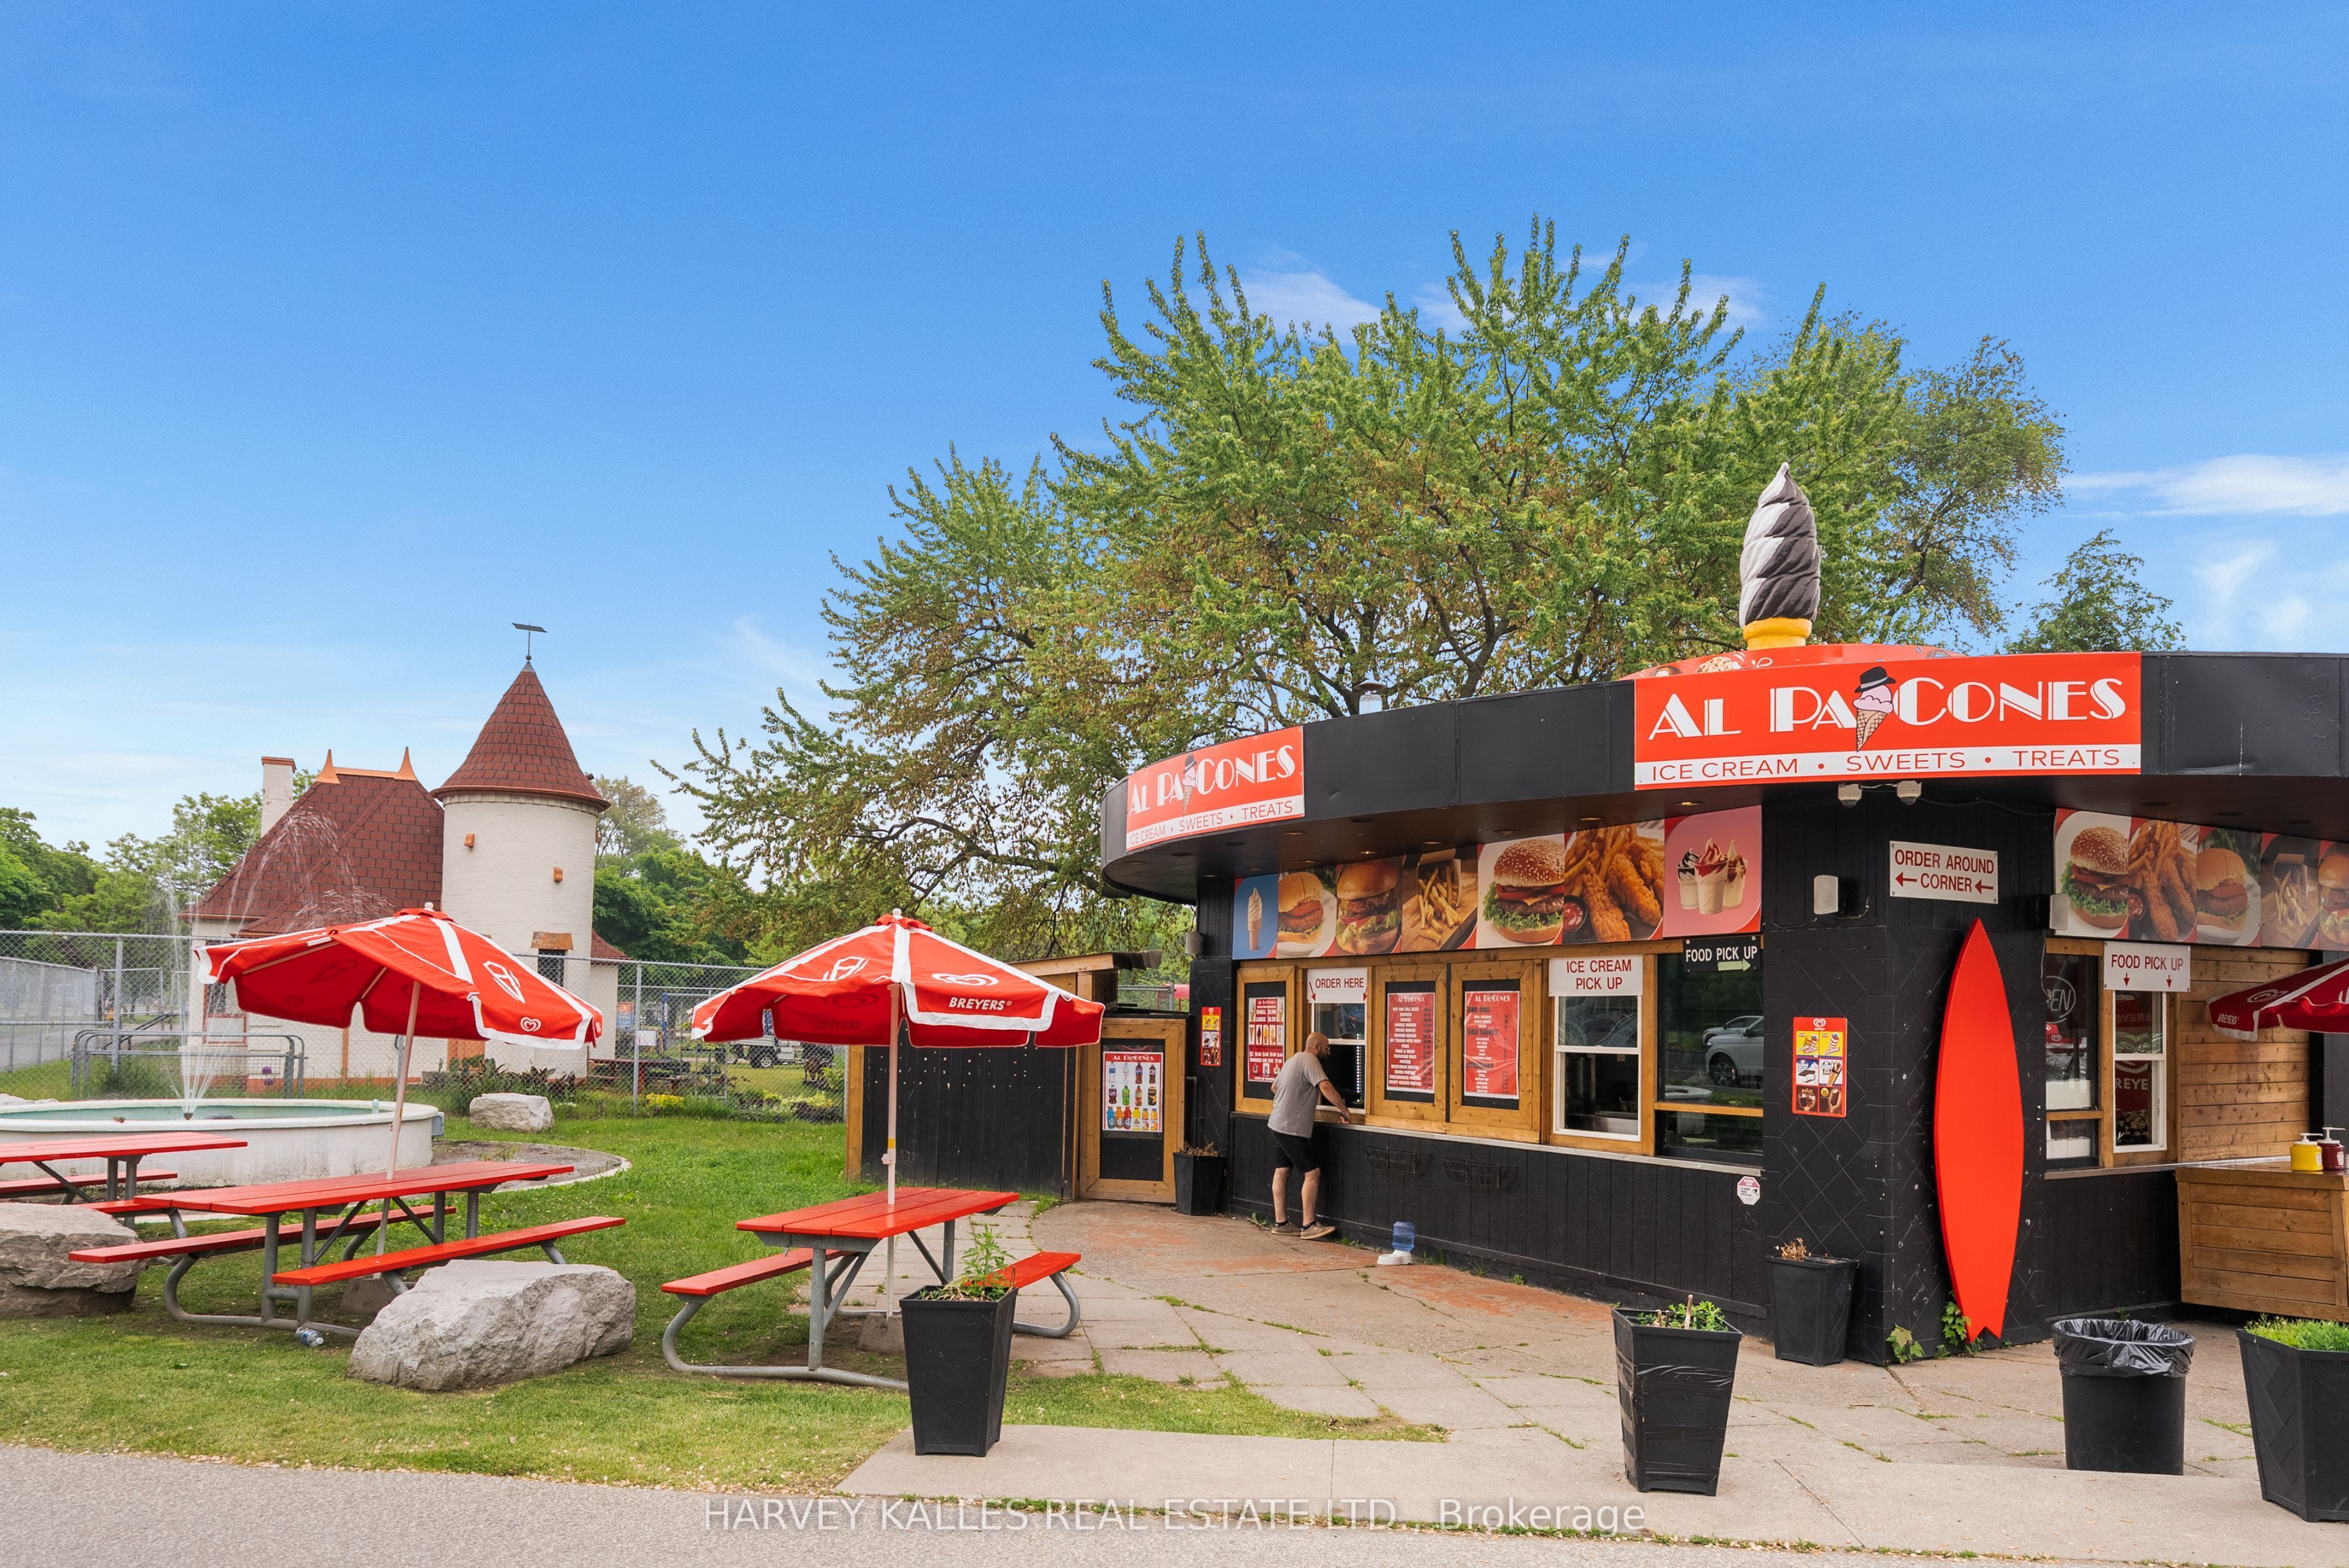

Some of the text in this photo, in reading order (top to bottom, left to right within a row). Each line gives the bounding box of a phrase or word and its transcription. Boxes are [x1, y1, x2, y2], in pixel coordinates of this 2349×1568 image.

[1649, 692, 1742, 741] AL
[1653, 748, 2120, 781] ICE CREAM SWEETS TREATS
[1129, 783, 1151, 816] AL
[1129, 800, 1293, 846] ICE CREAM SWEETS TREATS
[1894, 849, 1995, 875] ORDER AROUND
[1920, 872, 1973, 892] CORNER
[1685, 945, 1758, 963] FOOD PICK UP
[2110, 953, 2184, 971] FOOD PICK UP
[1566, 959, 1632, 973] ICE CREAM
[1315, 977, 1364, 989] ORDER HERE
[1575, 977, 1623, 990] PICK UP
